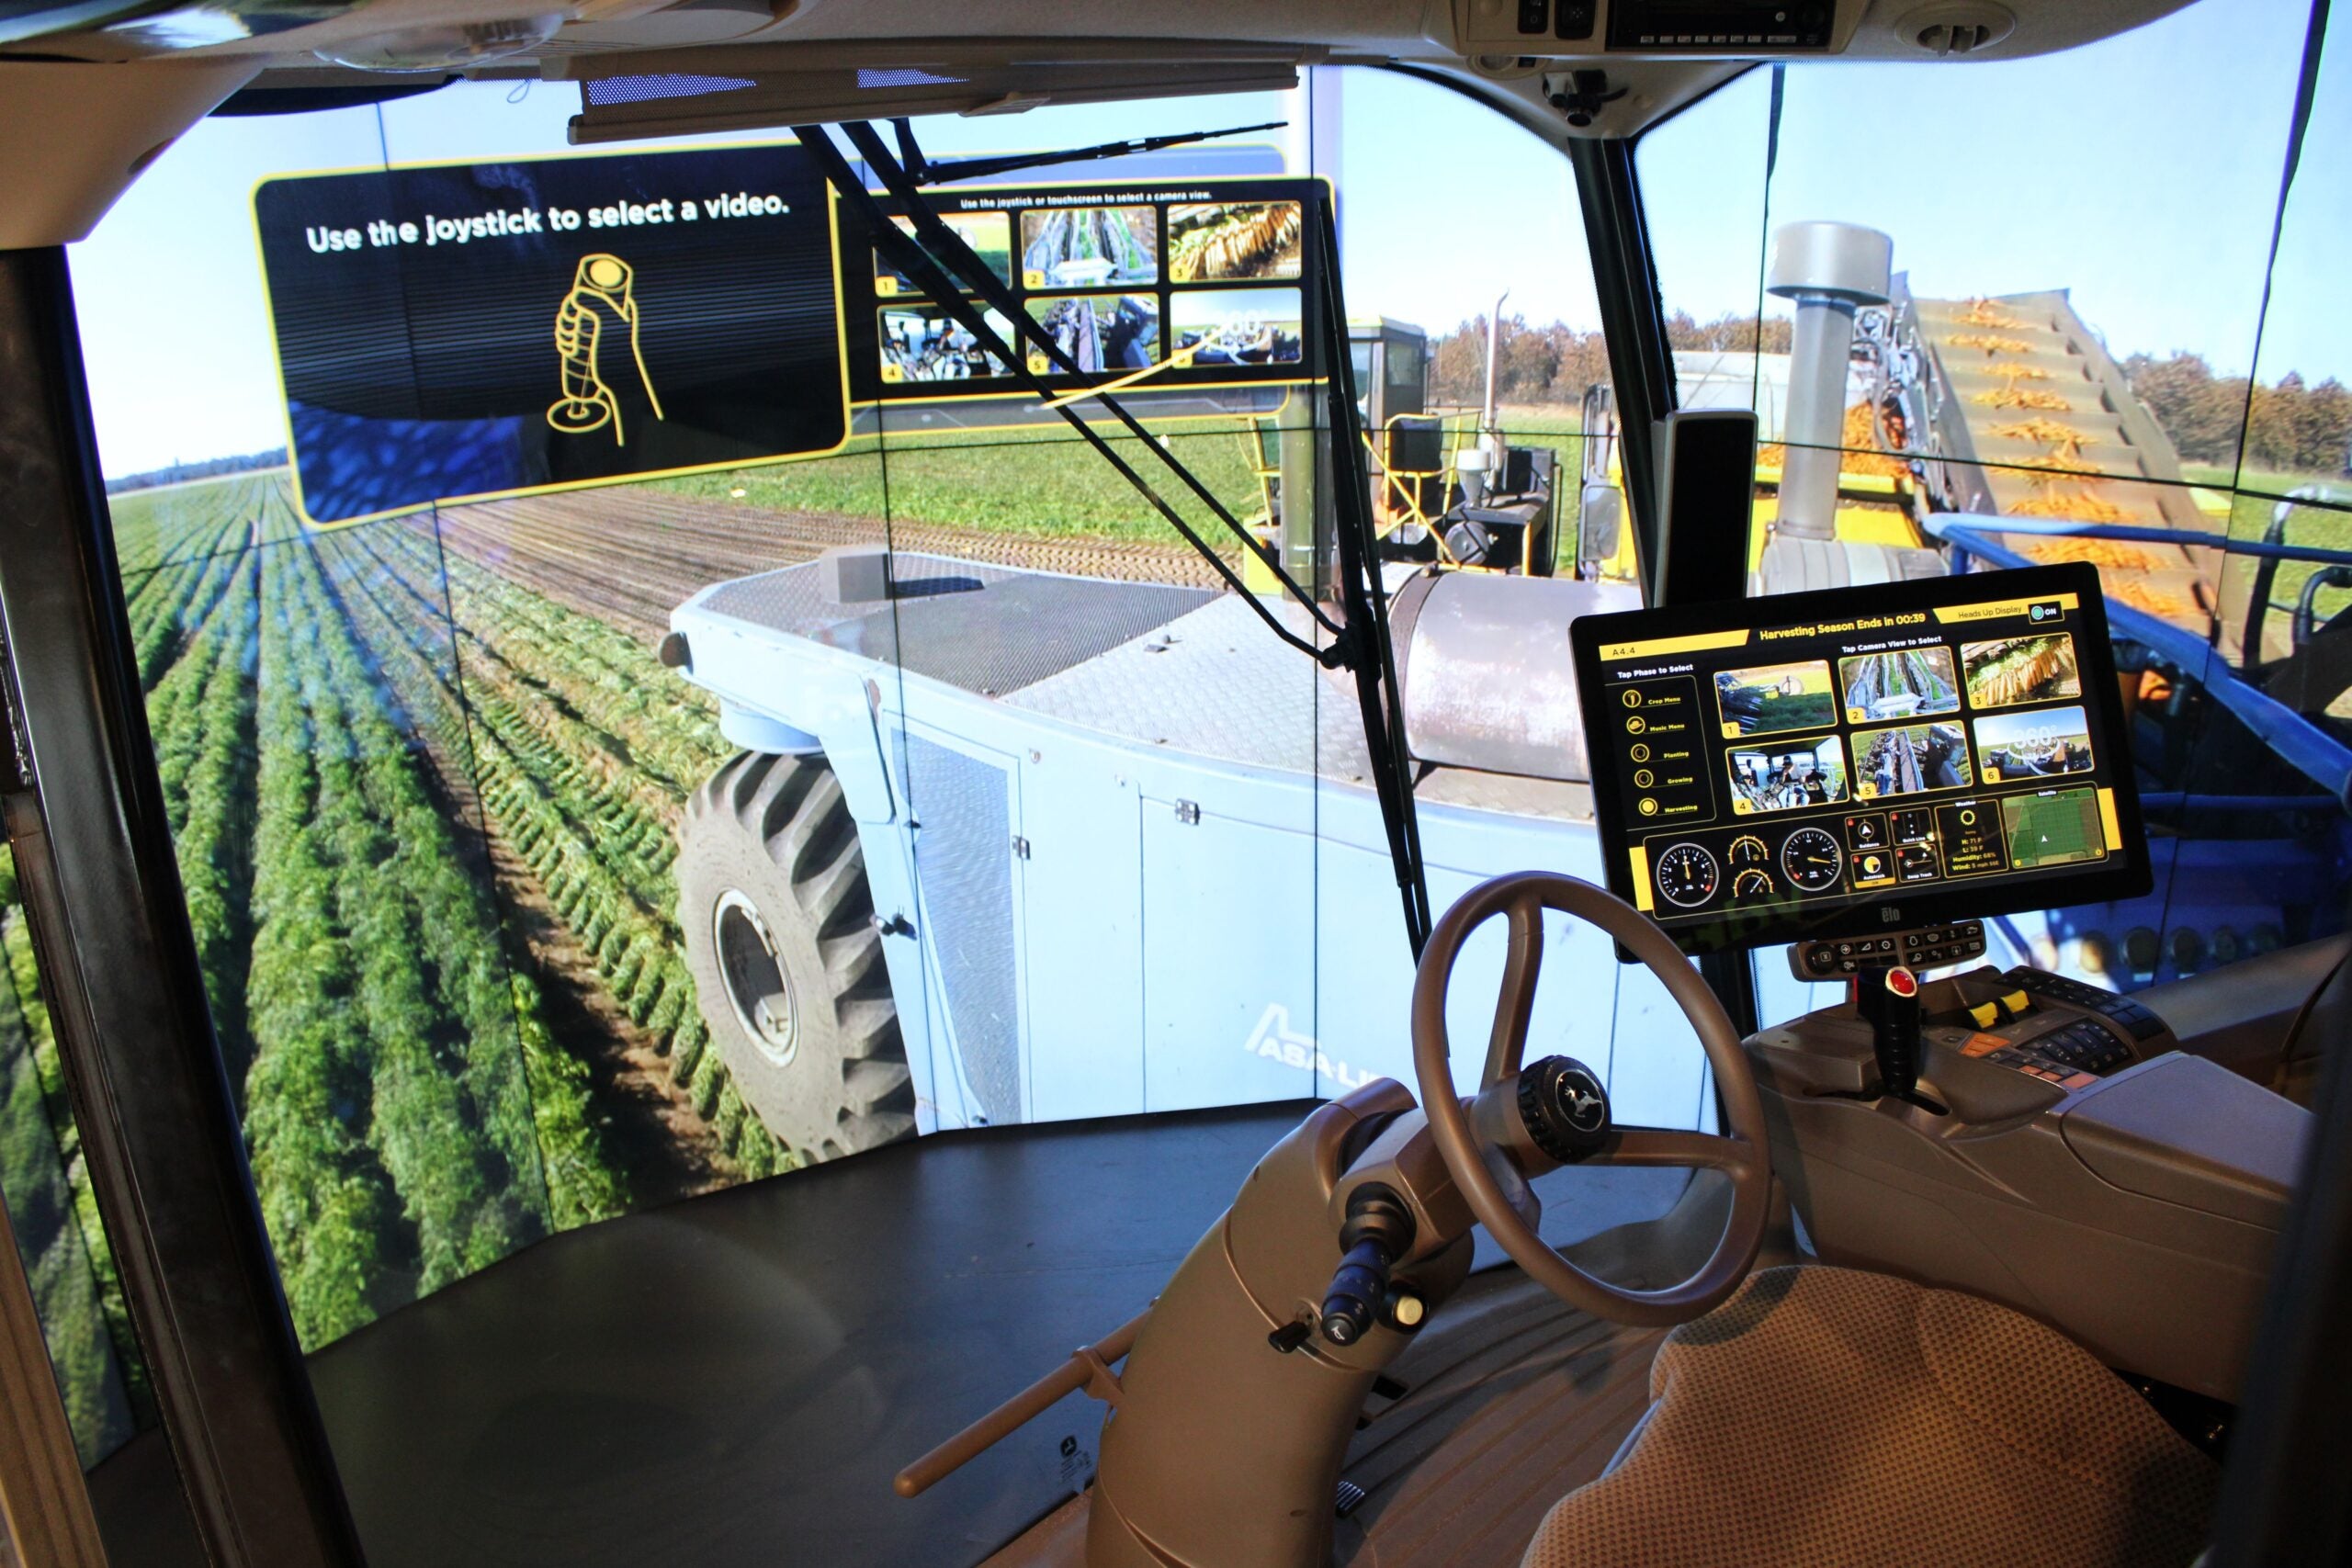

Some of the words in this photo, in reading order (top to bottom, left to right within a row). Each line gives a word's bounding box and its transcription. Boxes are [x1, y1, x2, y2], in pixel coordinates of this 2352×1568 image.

[960, 198, 978, 209] Use
[979, 197, 996, 209] the
[997, 196, 1033, 209] joystick
[1035, 197, 1046, 207] or
[1047, 194, 1102, 206] touchscreen
[1104, 193, 1115, 203] to
[1116, 192, 1145, 203] select
[1146, 193, 1152, 202] a
[1154, 191, 1187, 202] camera
[1189, 189, 1212, 200] view.
[306, 226, 363, 254] Use
[367, 220, 419, 247] the
[424, 207, 544, 246] joystick
[548, 207, 582, 231] to
[588, 198, 674, 228] select
[680, 200, 698, 220] a
[704, 191, 790, 220] video.
[1177, 268, 1183, 277] 3
[1030, 275, 1038, 284] 2
[1034, 360, 1041, 370] 5
[888, 367, 896, 378] 4
[1958, 610, 1982, 619] Heads
[1983, 608, 1994, 618] Up
[1995, 605, 2022, 615] Display
[1759, 626, 1815, 641] Harvesting
[1817, 621, 1855, 634] Season
[1856, 617, 1883, 630] Ends
[1883, 616, 1894, 626] in
[1895, 613, 1926, 626] 00:39
[1841, 645, 1856, 654] Tap
[1858, 642, 1886, 652] Camera
[1888, 639, 1906, 649] View
[1918, 635, 1942, 645] Select
[1612, 647, 1635, 656] A4.4
[1634, 669, 1657, 677] Phase
[1668, 663, 1694, 672] Select
[1975, 696, 1982, 705] 3
[1852, 710, 1860, 720] 2
[1649, 725, 1667, 733] Music
[1663, 750, 1690, 760] Planting
[1667, 776, 1693, 784] Growing
[1987, 772, 1995, 780] 6
[1864, 786, 1871, 795] 5
[1664, 804, 1698, 814] Harvesting
[1739, 801, 1747, 810] 4
[1952, 854, 1983, 863] Humidity:
